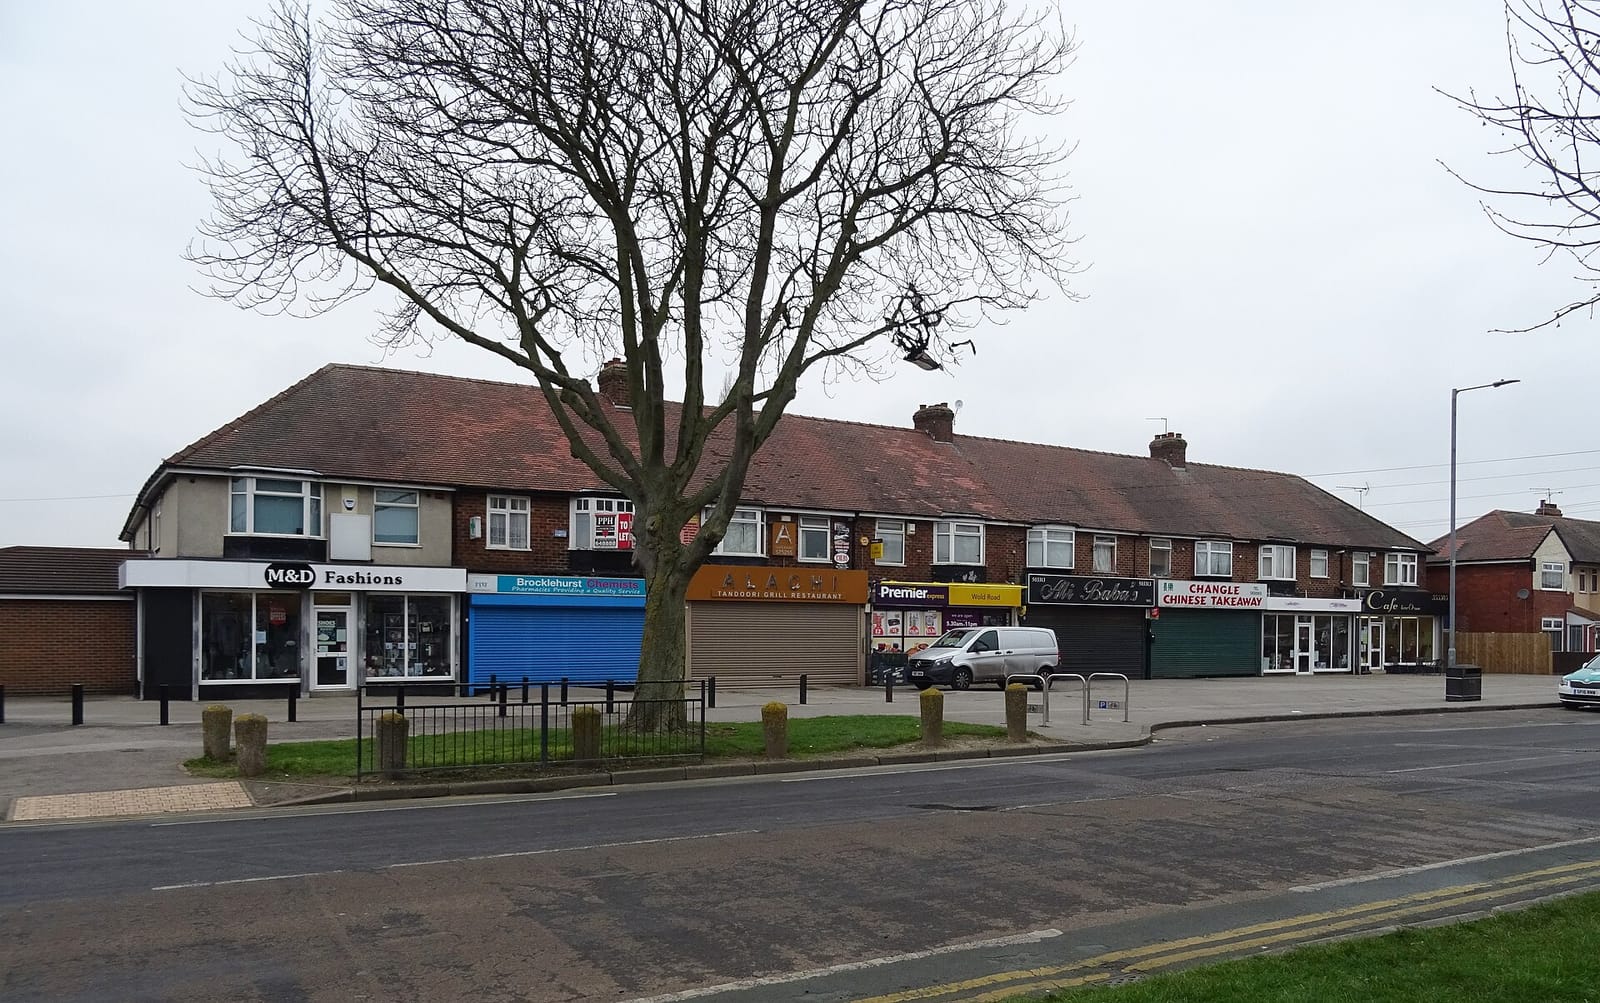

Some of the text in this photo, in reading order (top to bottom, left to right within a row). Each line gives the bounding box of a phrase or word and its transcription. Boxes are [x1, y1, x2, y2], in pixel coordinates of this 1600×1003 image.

[620, 521, 629, 530] TO
[619, 532, 629, 541] LET
[267, 569, 403, 585] M&D Fashions
[516, 577, 639, 588] Brocklehurst Chemists
[881, 586, 928, 599] Premier
[1041, 579, 1076, 600] Ali
[1189, 584, 1240, 595] CHANGLE
[1163, 595, 1263, 606] CHINESE TAKEAWAY
